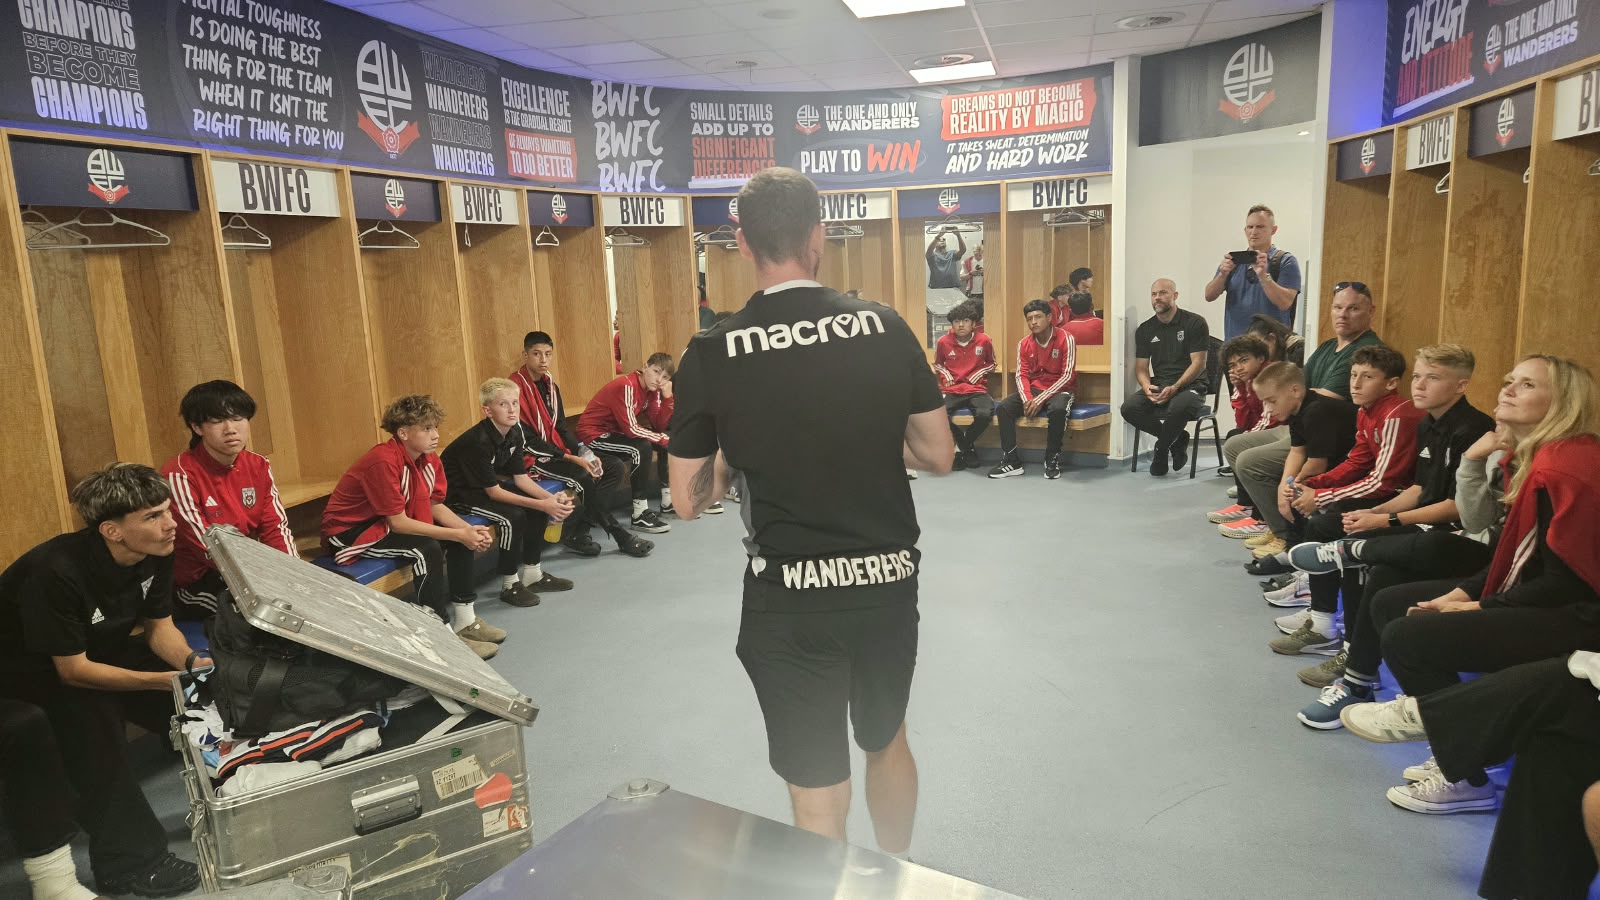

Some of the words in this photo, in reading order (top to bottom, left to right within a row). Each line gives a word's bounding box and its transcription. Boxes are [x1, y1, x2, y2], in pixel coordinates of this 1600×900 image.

[17, 0, 136, 50] CHAMPIONS
[246, 0, 322, 40] TOUGHNESS
[1505, 16, 1520, 46] THE
[1520, 7, 1537, 40] ONE
[22, 31, 92, 58] BEFORE
[95, 46, 136, 66] THEY
[190, 15, 204, 39] IS
[208, 20, 257, 55] DOING
[260, 33, 286, 59] THE
[290, 41, 321, 67] BEST
[1504, 20, 1579, 68] WANDERERS
[26, 49, 140, 90] BECOME
[182, 44, 232, 79] THING
[237, 56, 266, 81] FOR
[269, 64, 294, 89] THE
[297, 70, 332, 97] TEAM
[422, 50, 487, 92] WANDERERS
[31, 76, 148, 130] CHAMPIONS
[199, 78, 244, 109] WHEN
[251, 89, 264, 111] IT
[305, 99, 328, 122] THE
[425, 82, 489, 121] WANDERERS
[501, 77, 571, 117] EXCELLENCE
[591, 80, 660, 119] BWFC
[690, 102, 726, 121] SMALL
[728, 103, 773, 121] DETAILS
[824, 105, 843, 120] THE
[845, 104, 865, 120] ONE
[868, 103, 888, 119] AND
[891, 101, 918, 118] ONLY
[951, 94, 995, 114] DREAMS
[998, 92, 1012, 108] DO
[1015, 89, 1036, 107] NOT
[1038, 82, 1082, 104] BECOME
[193, 109, 244, 138] RIGHT
[248, 117, 291, 147] THING
[295, 125, 320, 146] FOR
[323, 128, 344, 150] YOU
[428, 113, 492, 149] WANDERERS
[503, 109, 510, 124] IS
[510, 110, 521, 127] THE
[521, 113, 549, 131] GRADUAL
[549, 116, 571, 133] RESULT
[692, 122, 724, 135] ADD
[727, 123, 748, 136] UP
[752, 123, 774, 136] TO
[826, 117, 920, 132] WANDERERS
[950, 109, 1008, 135] REALITY
[1012, 106, 1032, 129] BY
[1035, 100, 1084, 127] MAGIC
[594, 119, 664, 160] BWFC
[692, 136, 775, 158] SIGNIFICANT
[800, 150, 838, 174] PLAY
[841, 149, 861, 173] TO
[867, 139, 921, 174] WIN
[945, 153, 982, 174] AND
[987, 149, 1034, 172] HARD
[1038, 141, 1089, 165] WORK
[947, 143, 957, 154] IT
[958, 141, 983, 153] TAKES
[1018, 128, 1089, 147] DETERMINATION
[1419, 116, 1450, 164] BWFC
[432, 144, 495, 176] WANDERERS
[510, 150, 522, 174] TO
[522, 152, 535, 175] DO
[537, 154, 574, 178] BETTER
[598, 158, 666, 192] BWFC
[238, 162, 311, 213] BWFC
[462, 186, 503, 222] BWFC
[1032, 178, 1088, 208] BWFC
[620, 196, 664, 224] BWFC
[726, 310, 885, 358] macron
[782, 550, 915, 590] WANDERERS
